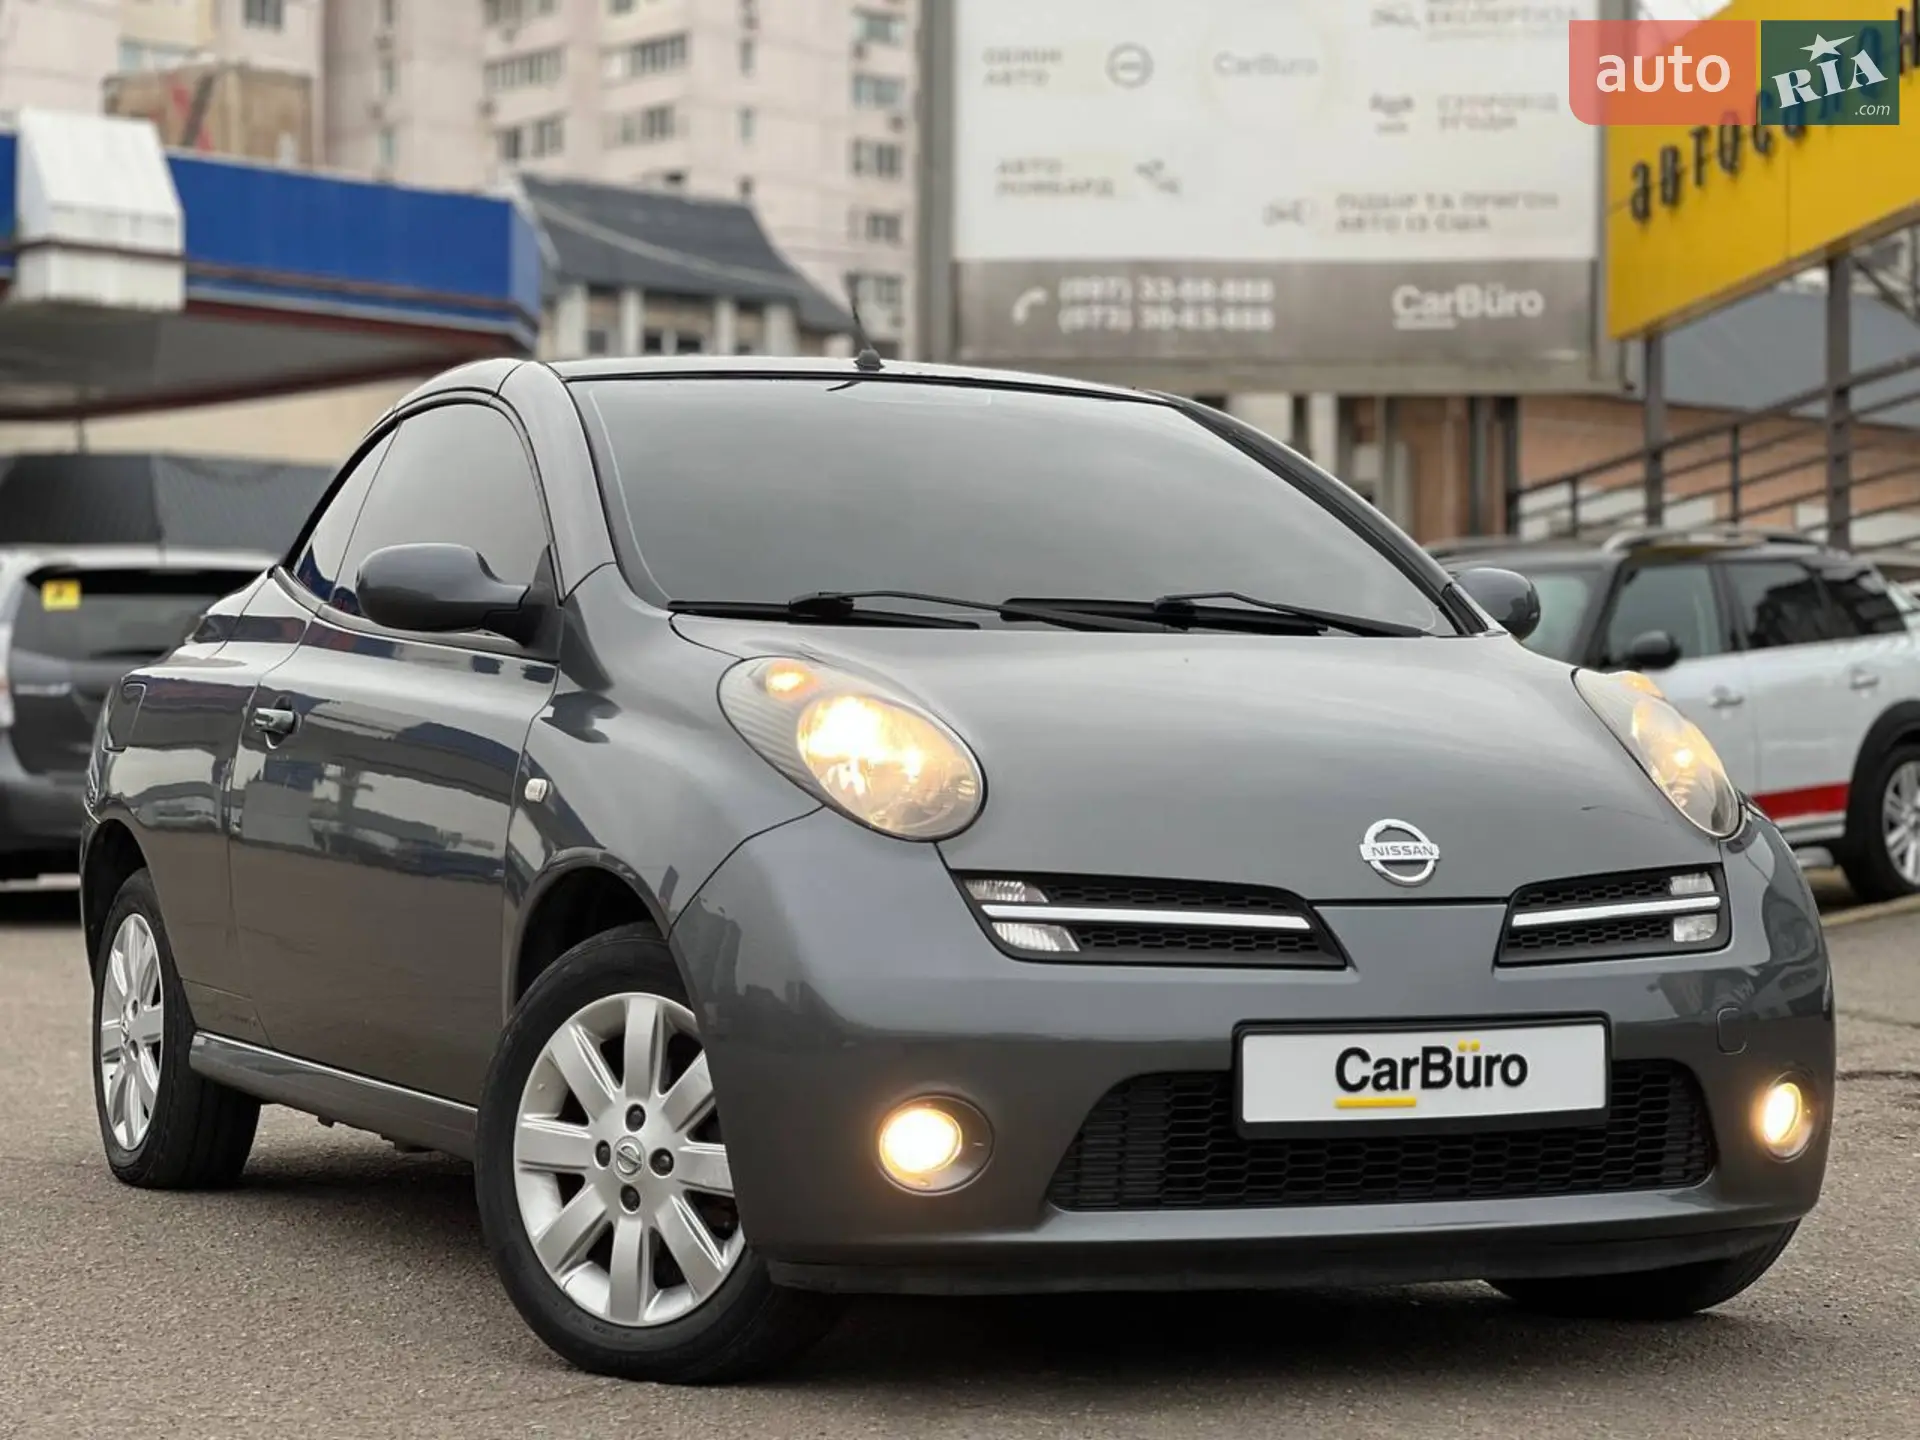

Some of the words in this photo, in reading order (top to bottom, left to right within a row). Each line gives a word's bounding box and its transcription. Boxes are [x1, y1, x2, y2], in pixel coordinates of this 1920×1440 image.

[1391, 283, 1545, 319] CarBüro
[1371, 845, 1435, 857] NISSAN
[1335, 1041, 1528, 1092] CarBüro
